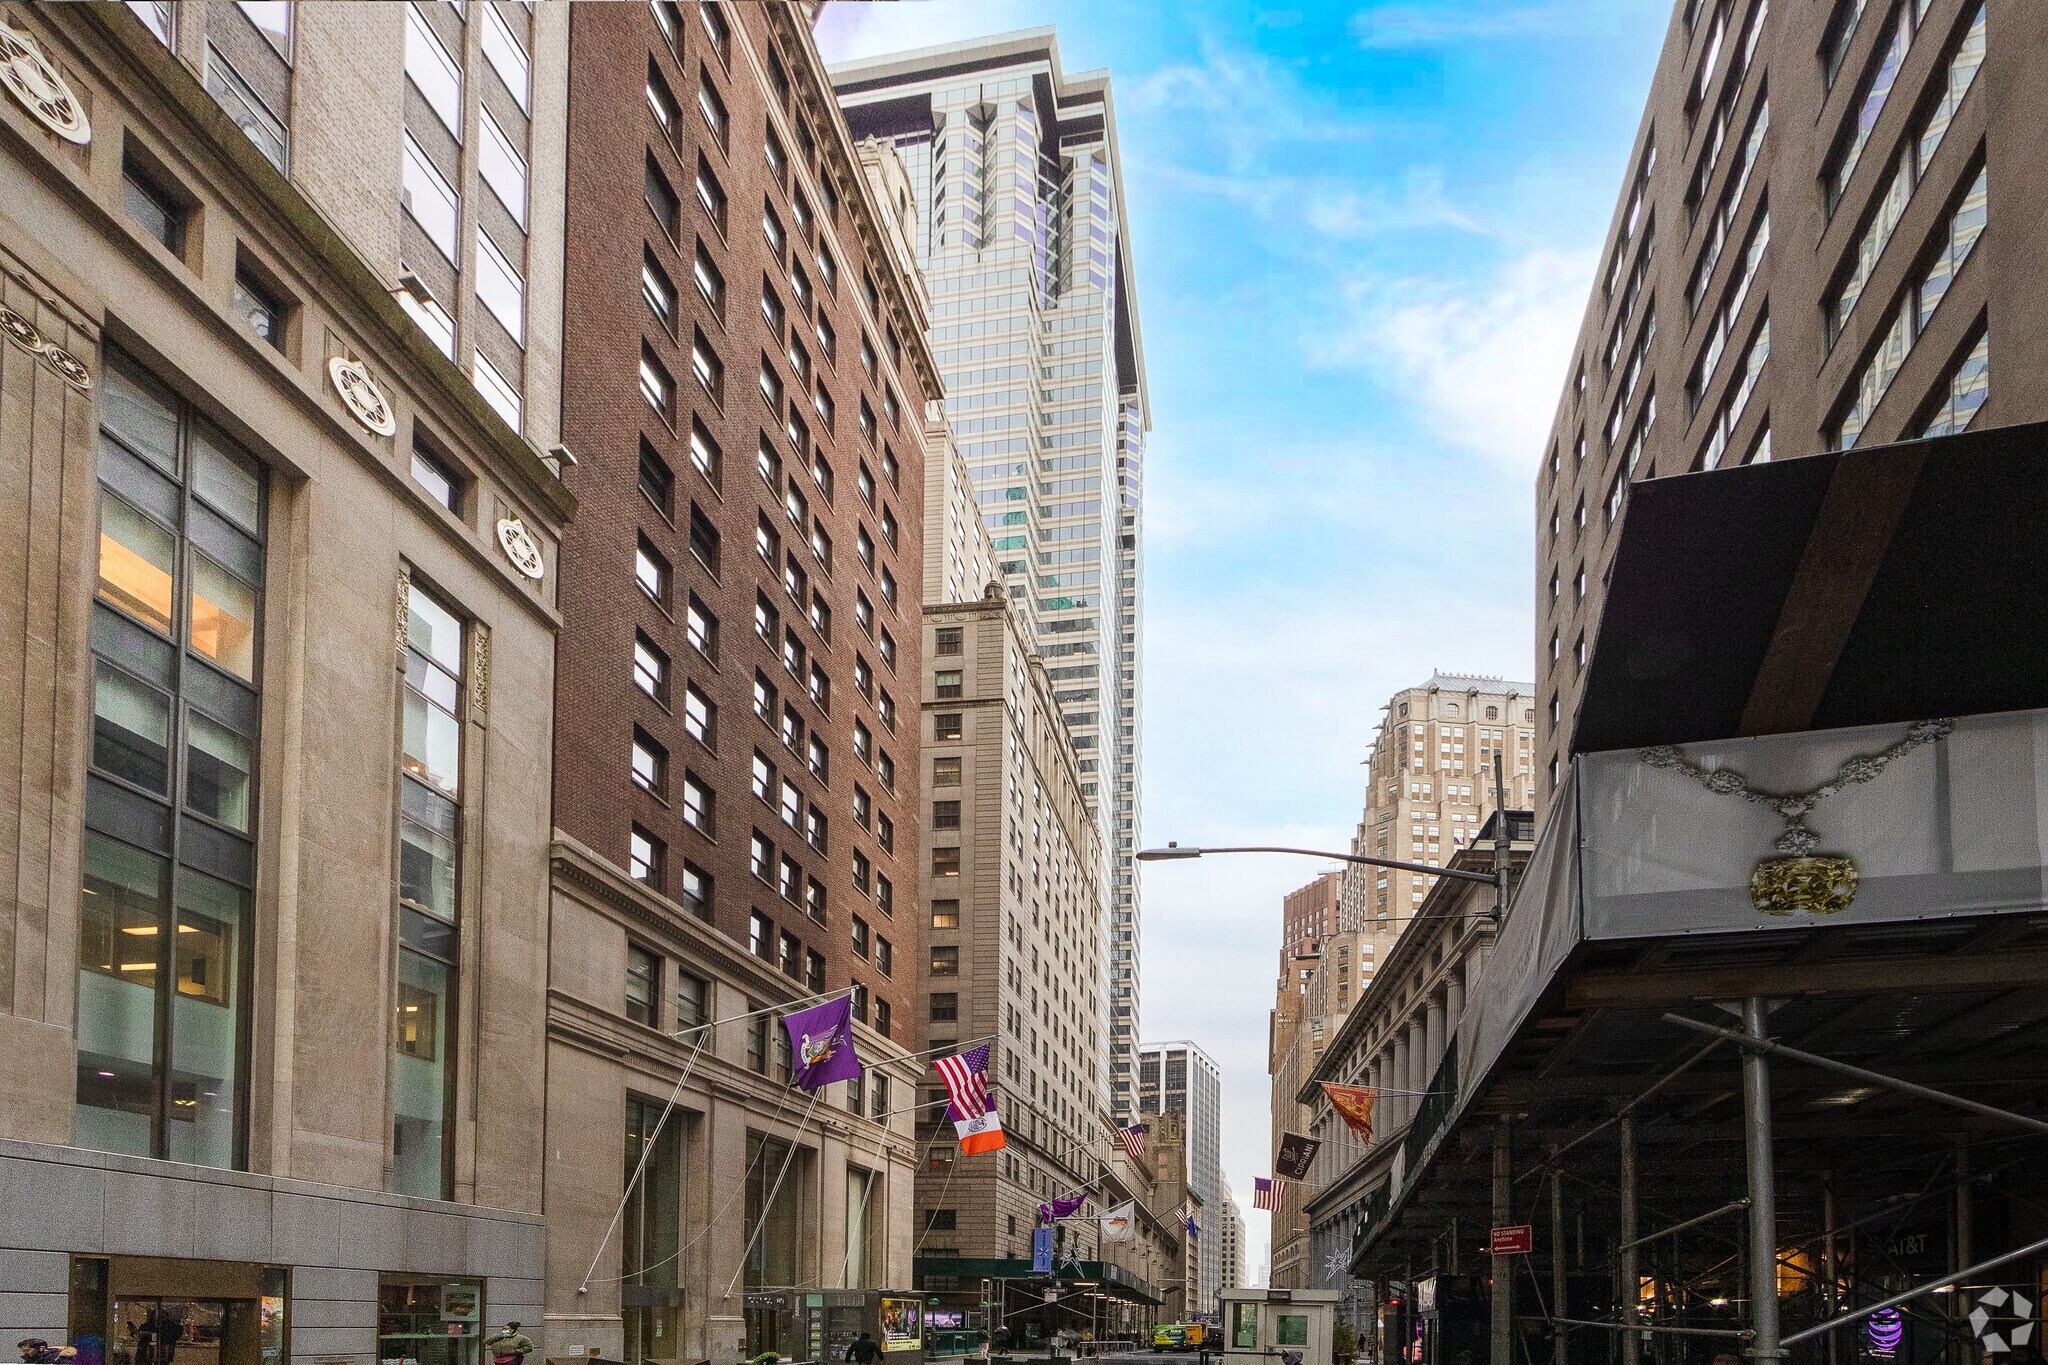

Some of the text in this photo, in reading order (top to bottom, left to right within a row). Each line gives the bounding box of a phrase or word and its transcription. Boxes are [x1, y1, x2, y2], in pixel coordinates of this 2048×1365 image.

[1294, 1143, 1315, 1175] CIPRIANI
[1501, 1229, 1525, 1237] STANDING
[1888, 1233, 1928, 1256] AT&T
